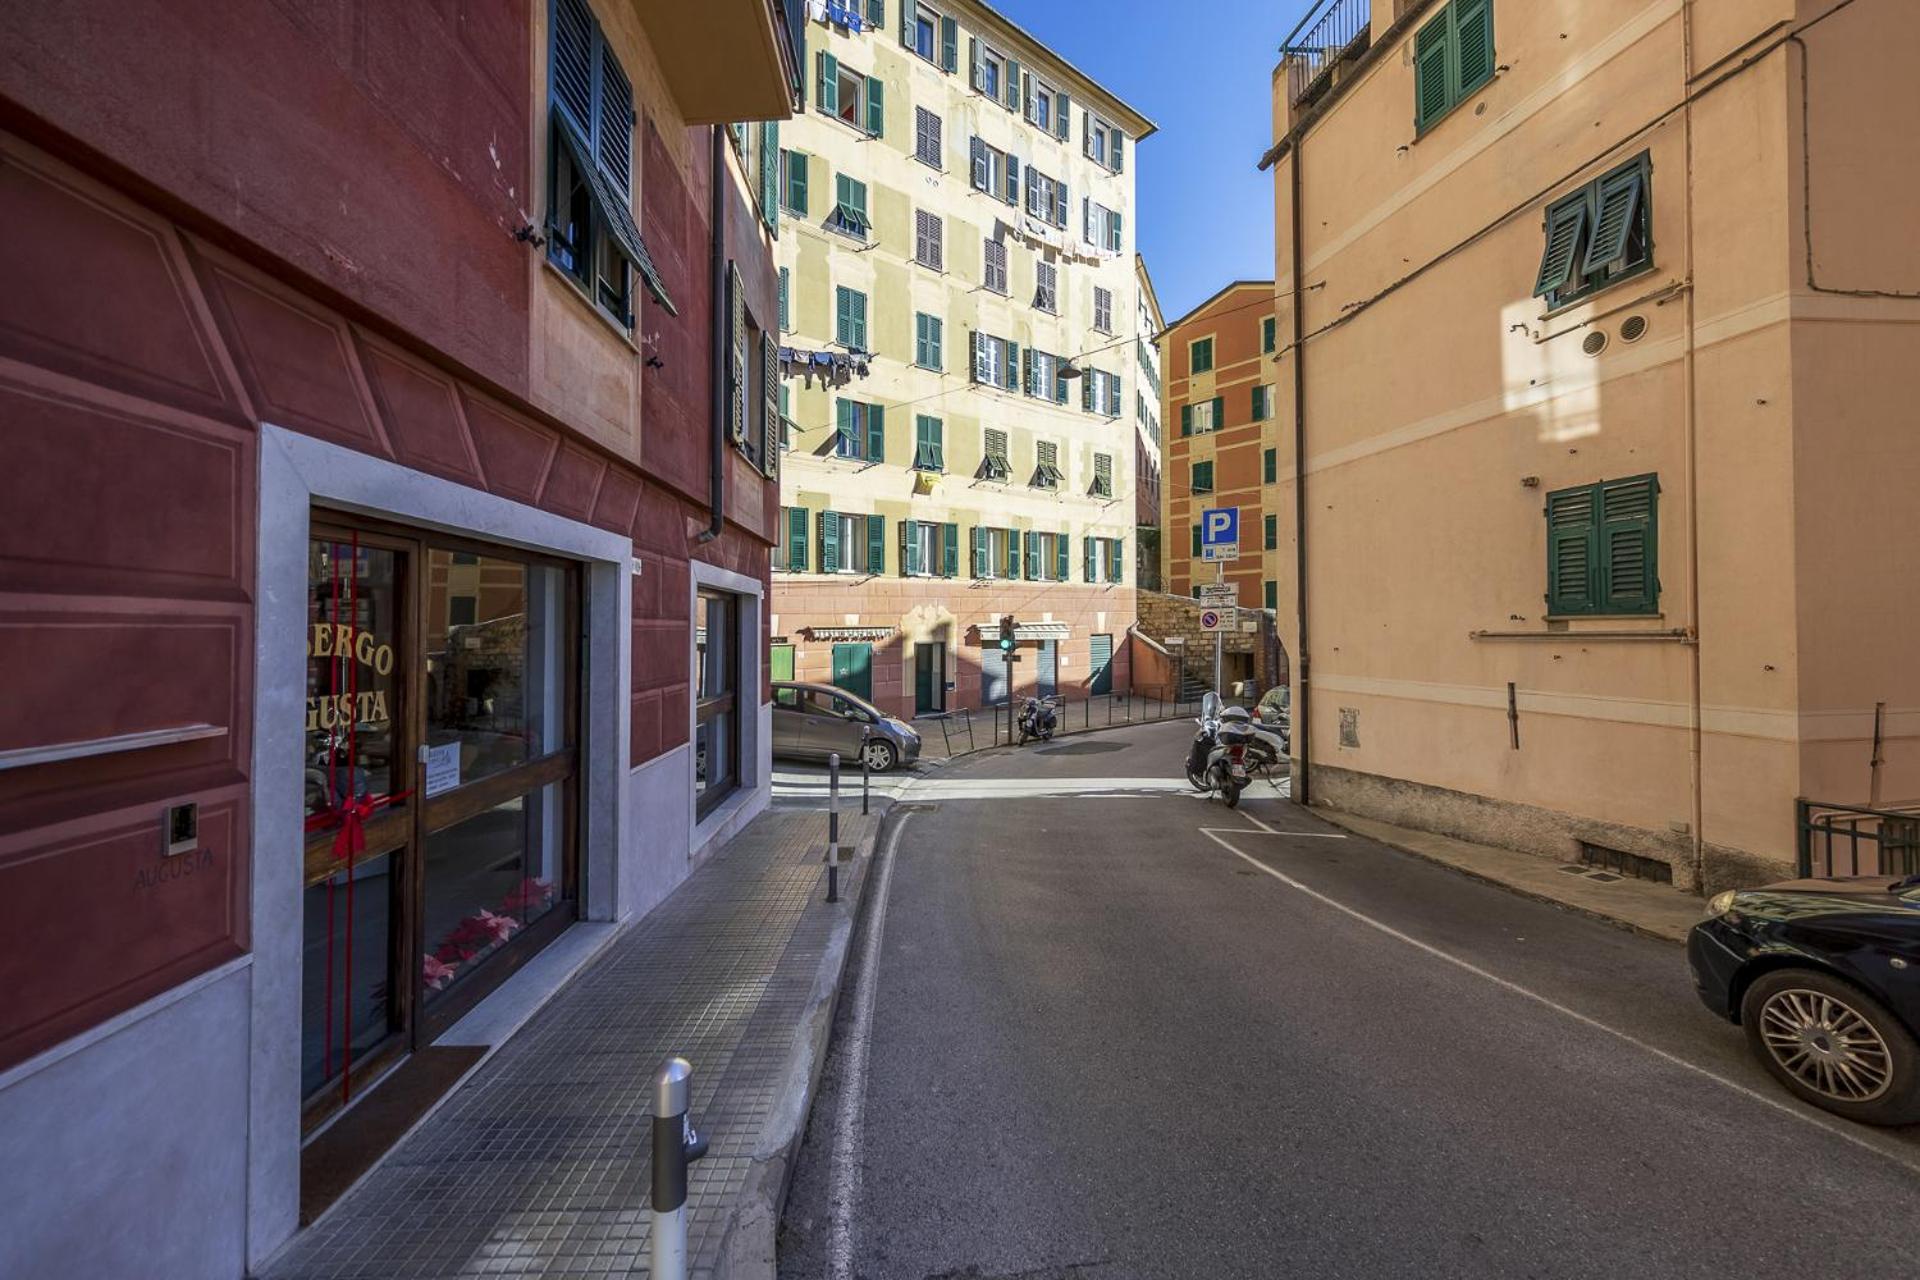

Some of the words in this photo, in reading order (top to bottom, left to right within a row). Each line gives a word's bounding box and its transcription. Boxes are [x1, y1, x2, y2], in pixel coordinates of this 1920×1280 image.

[1209, 512, 1231, 542] P
[307, 623, 394, 676] ERGO
[133, 848, 214, 894] AUGUSTA
